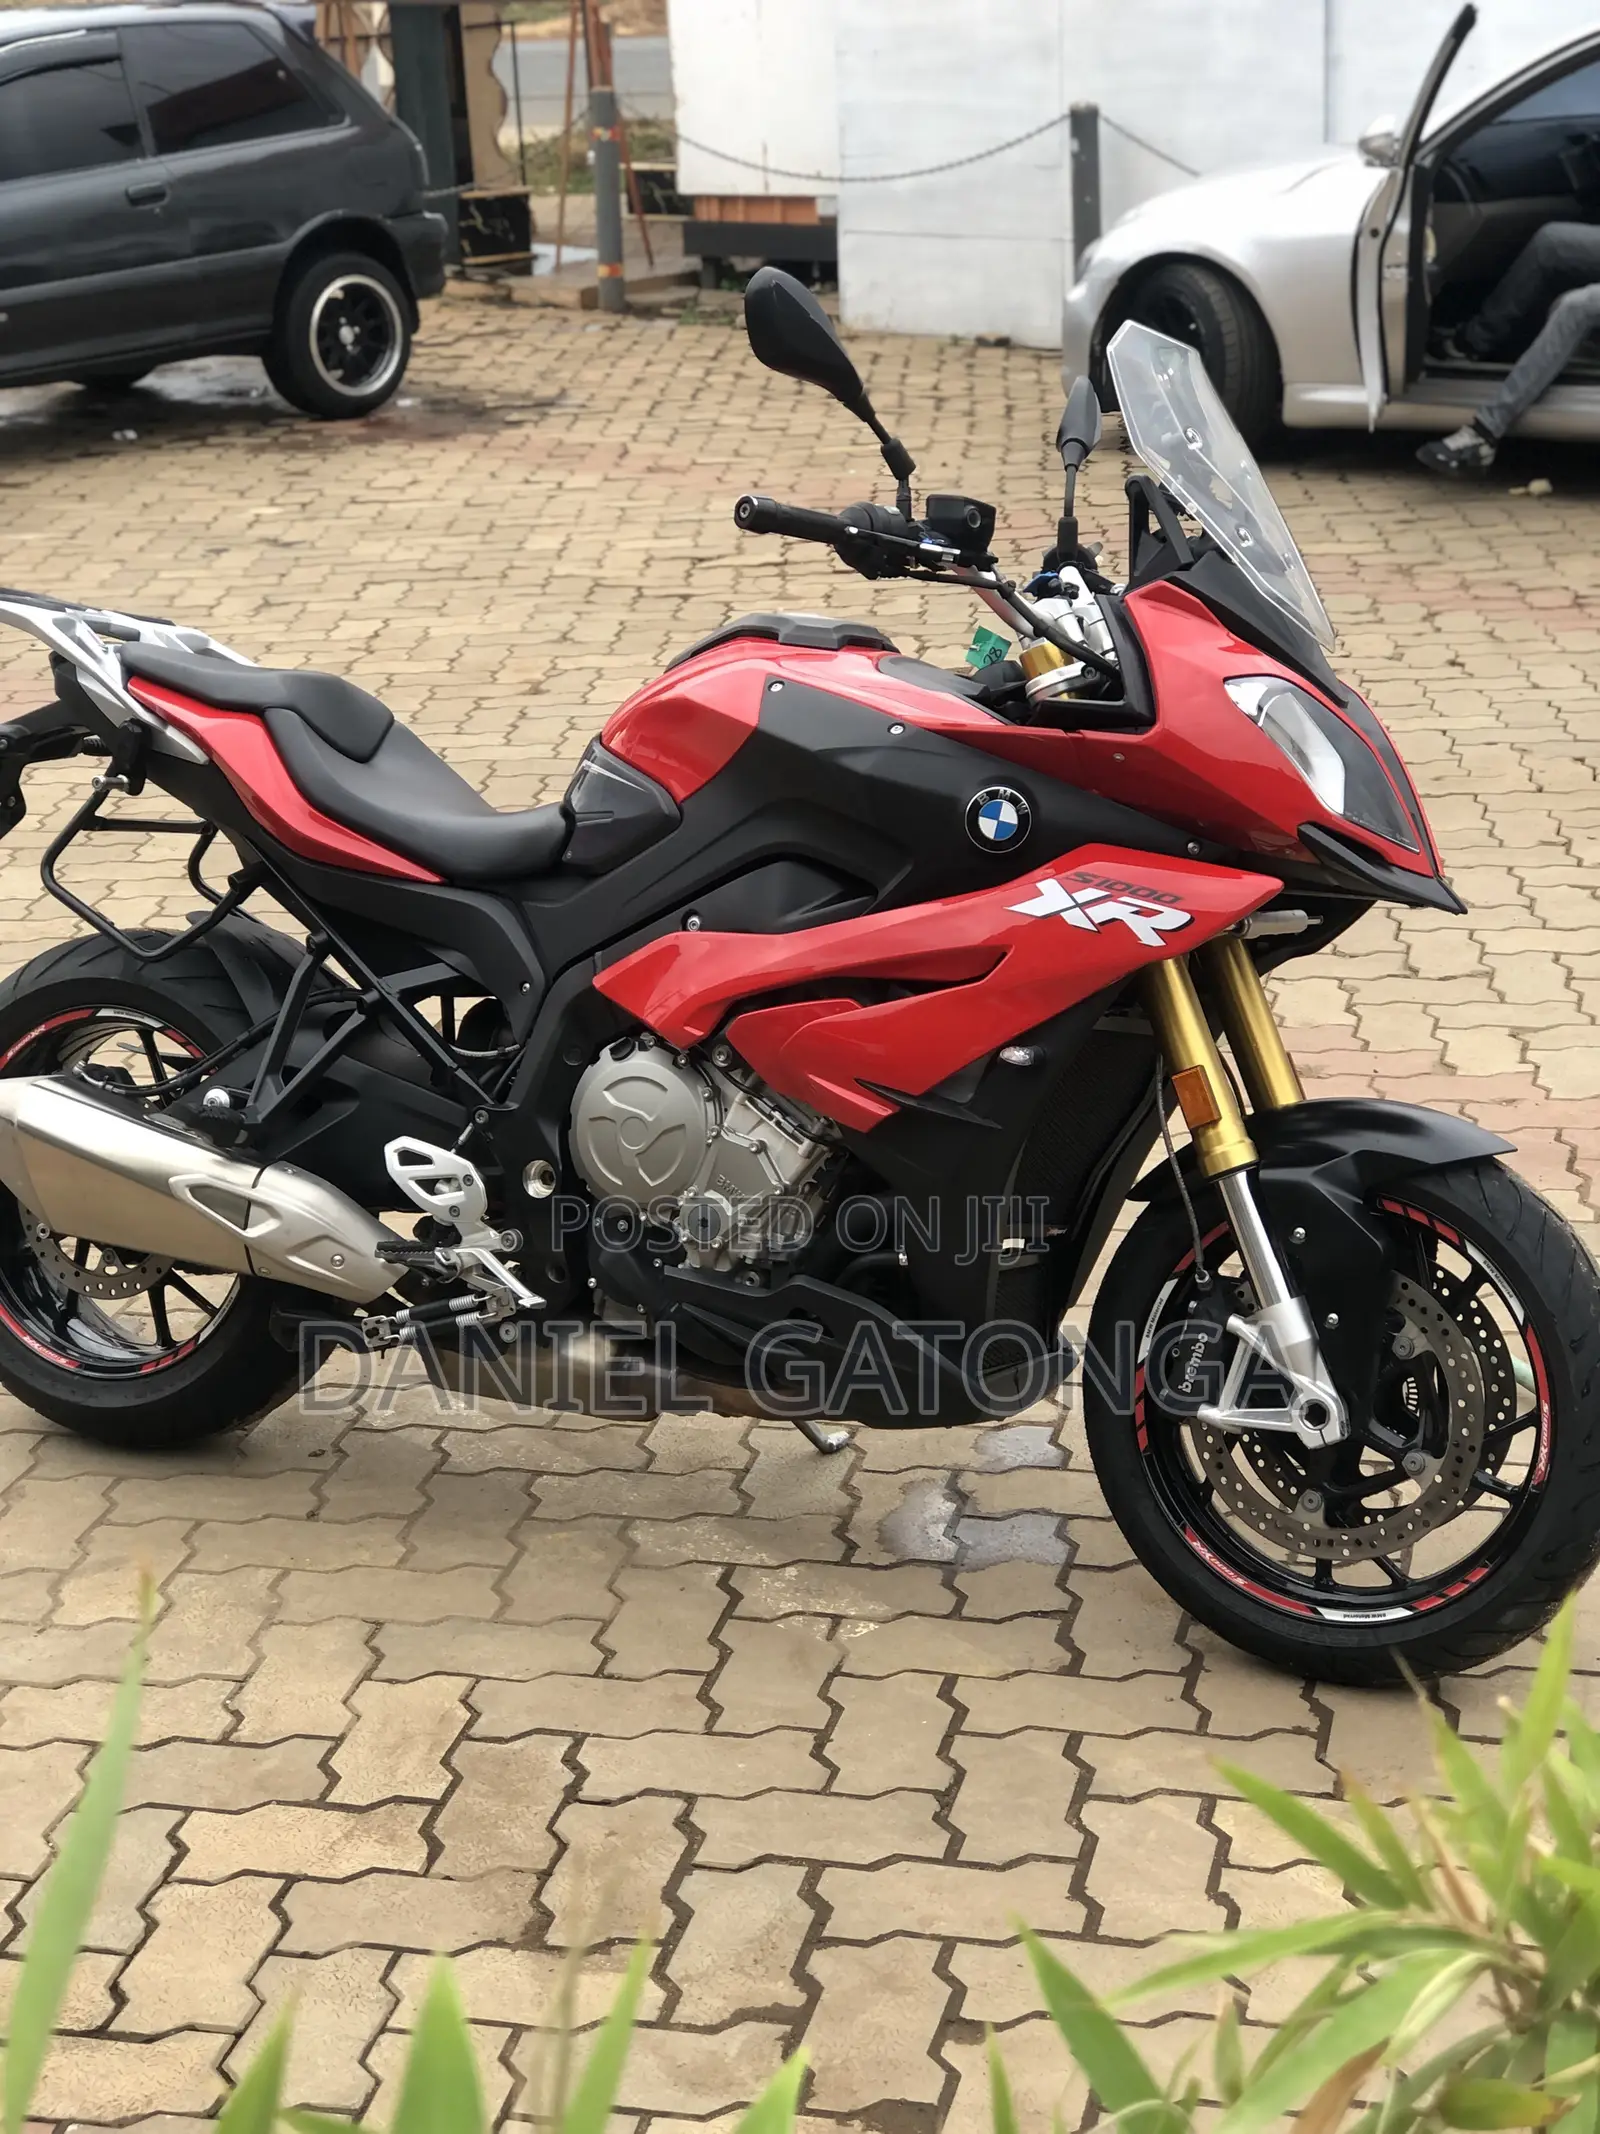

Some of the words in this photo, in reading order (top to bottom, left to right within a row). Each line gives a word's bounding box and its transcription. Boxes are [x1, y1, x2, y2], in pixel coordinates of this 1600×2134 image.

[977, 788, 1029, 815] BMW
[1065, 871, 1183, 904] S1000
[1003, 877, 1195, 948] XR
[1178, 1332, 1209, 1394] brembo
